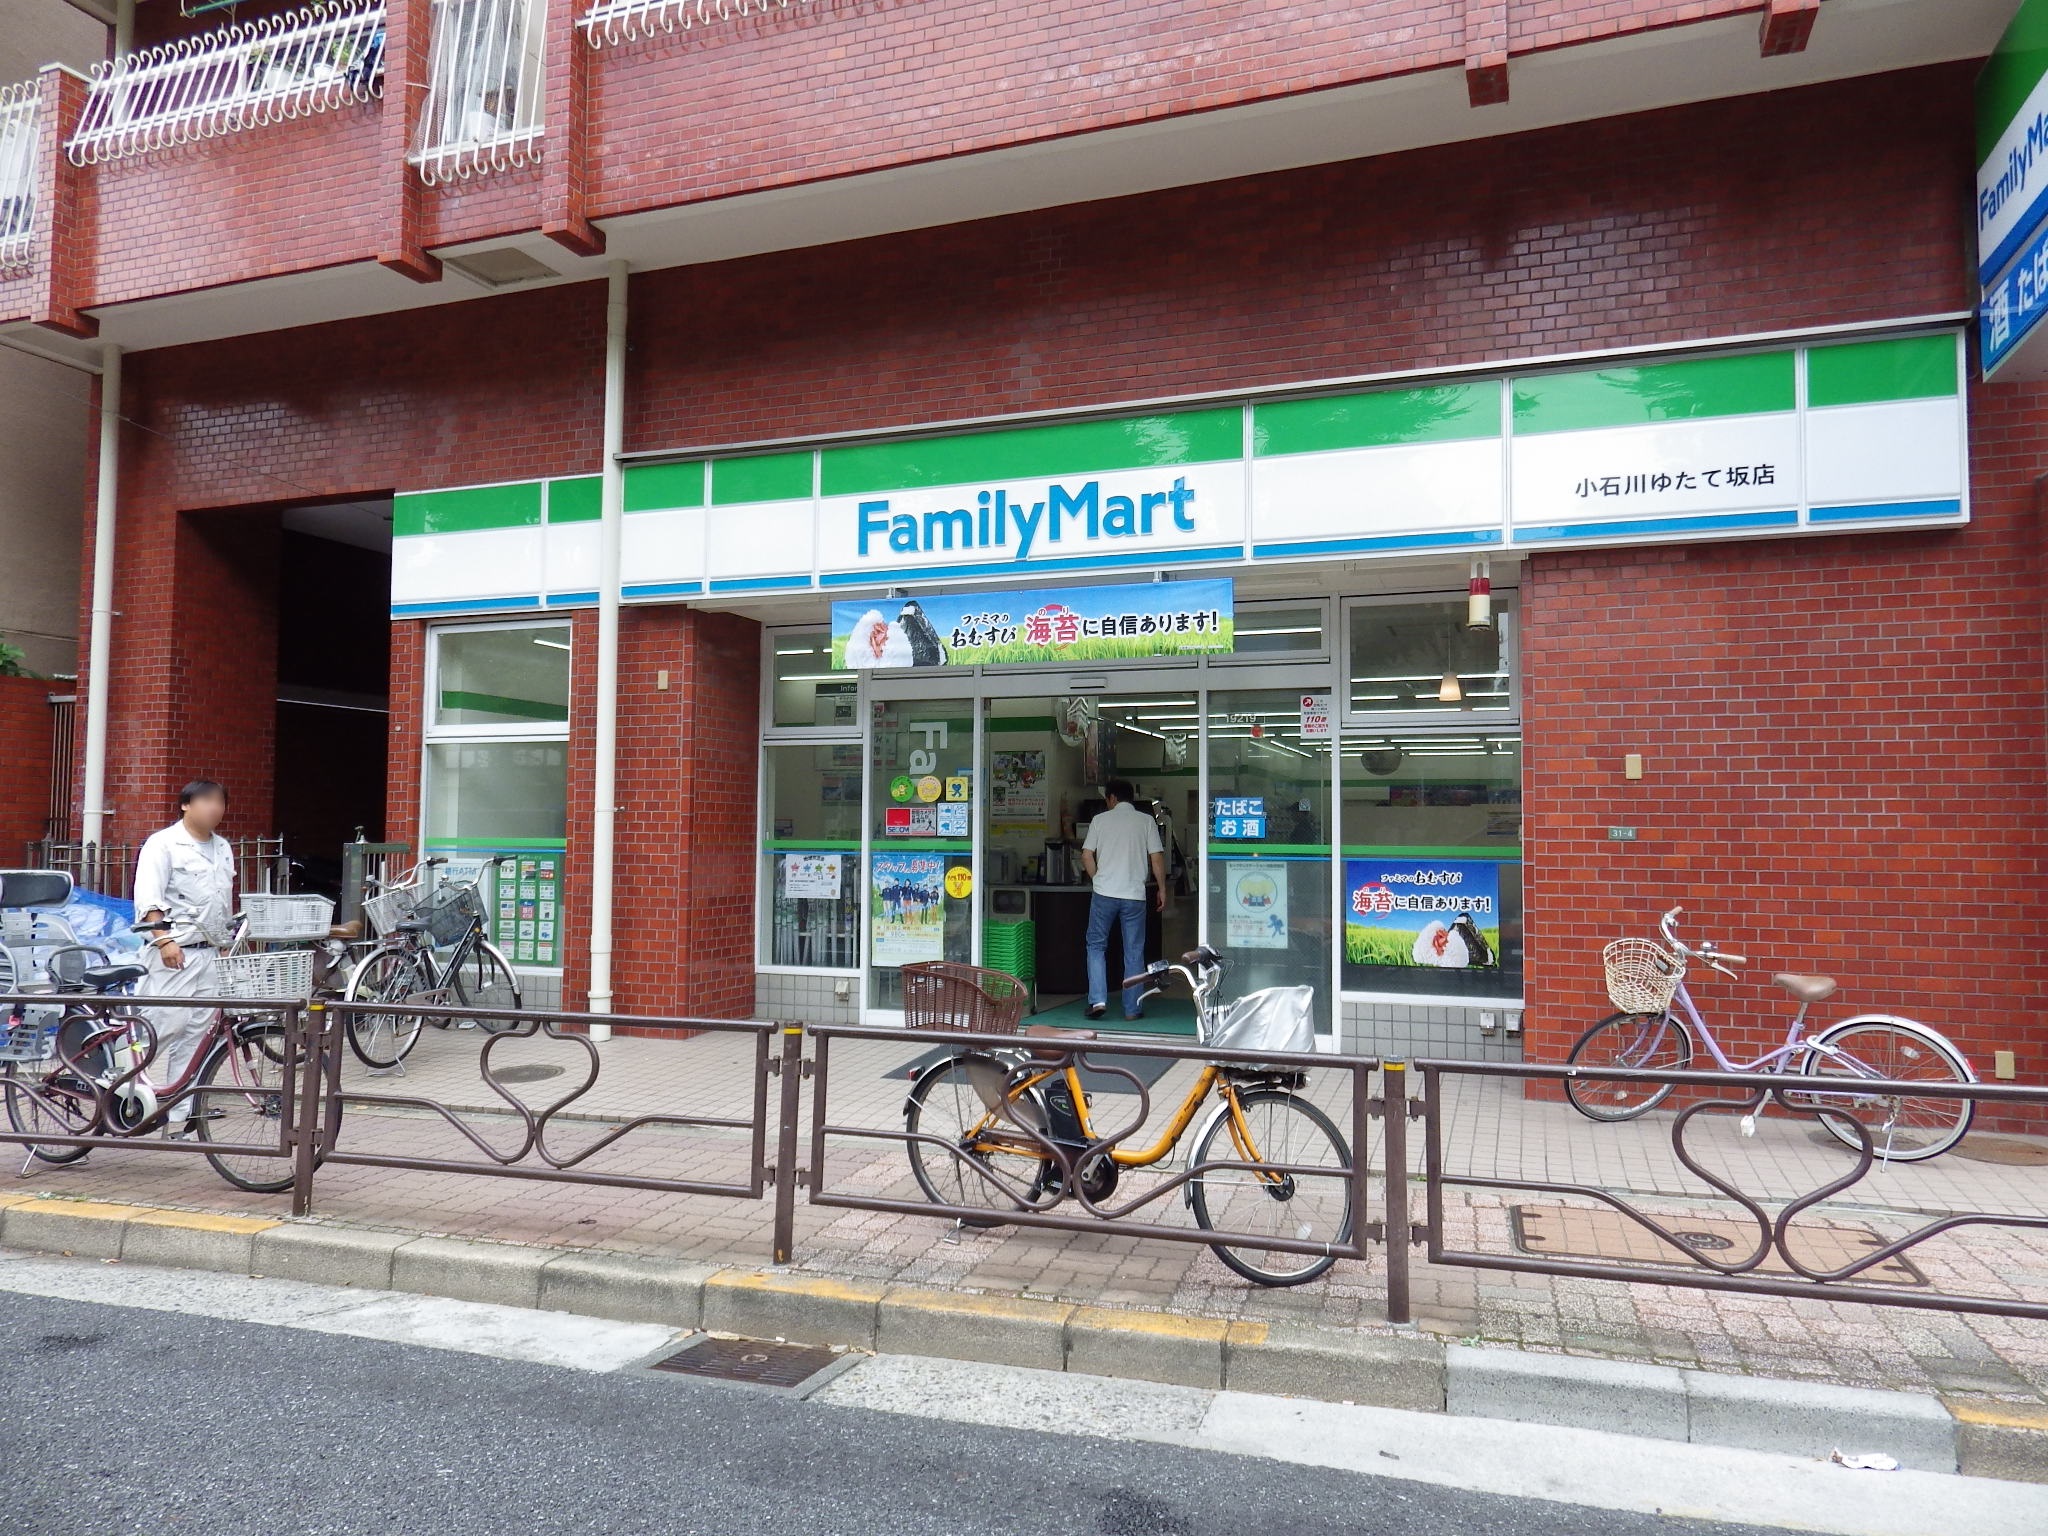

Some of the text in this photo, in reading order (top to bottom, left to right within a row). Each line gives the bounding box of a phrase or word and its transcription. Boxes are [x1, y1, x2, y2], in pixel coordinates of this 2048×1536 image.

[1989, 279, 2009, 351] 酒
[1576, 464, 1775, 497] 小石川ゆたて坂店
[858, 476, 1195, 559] FamilyMart
[962, 614, 1010, 626] ファミマの
[952, 627, 1016, 648] おむすび
[1226, 714, 1256, 723] 19219
[1216, 800, 1263, 816] たばこ
